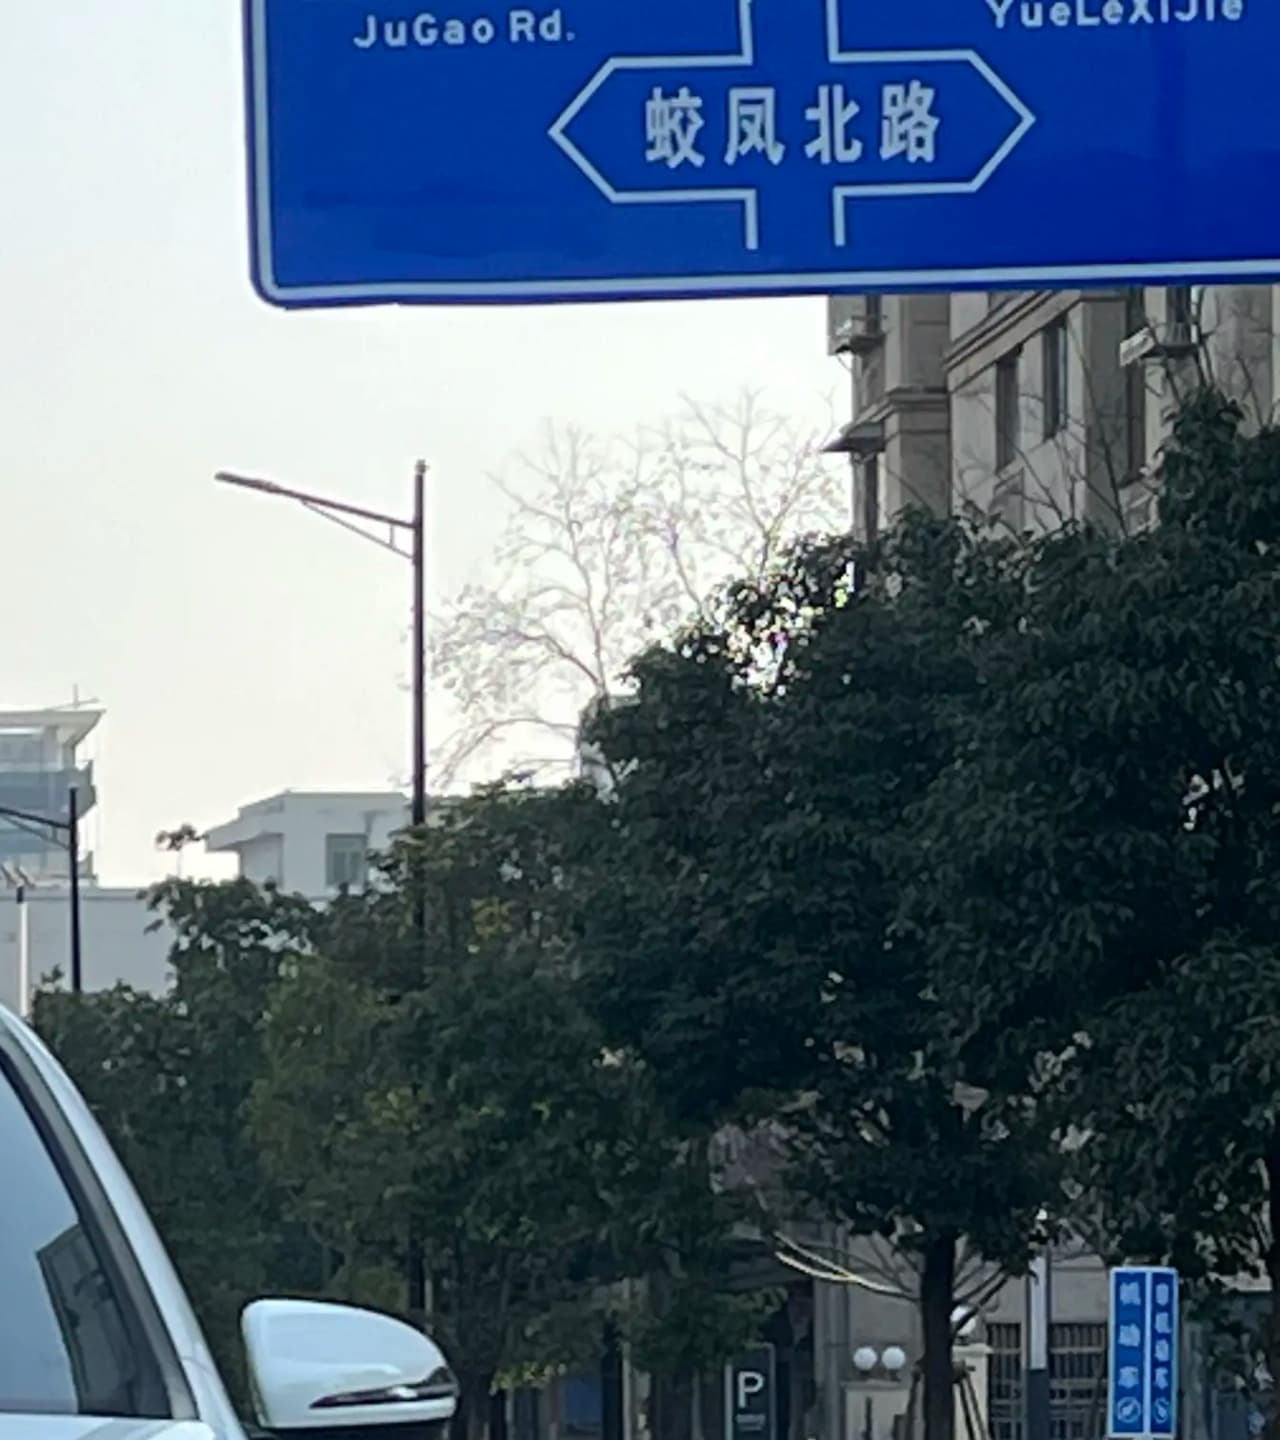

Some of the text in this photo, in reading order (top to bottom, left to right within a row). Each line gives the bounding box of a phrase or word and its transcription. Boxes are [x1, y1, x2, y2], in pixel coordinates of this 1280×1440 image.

[354, 10, 576, 47] JuGao Rd.
[646, 80, 939, 168] 蛟凤北路
[738, 1371, 764, 1408] P
